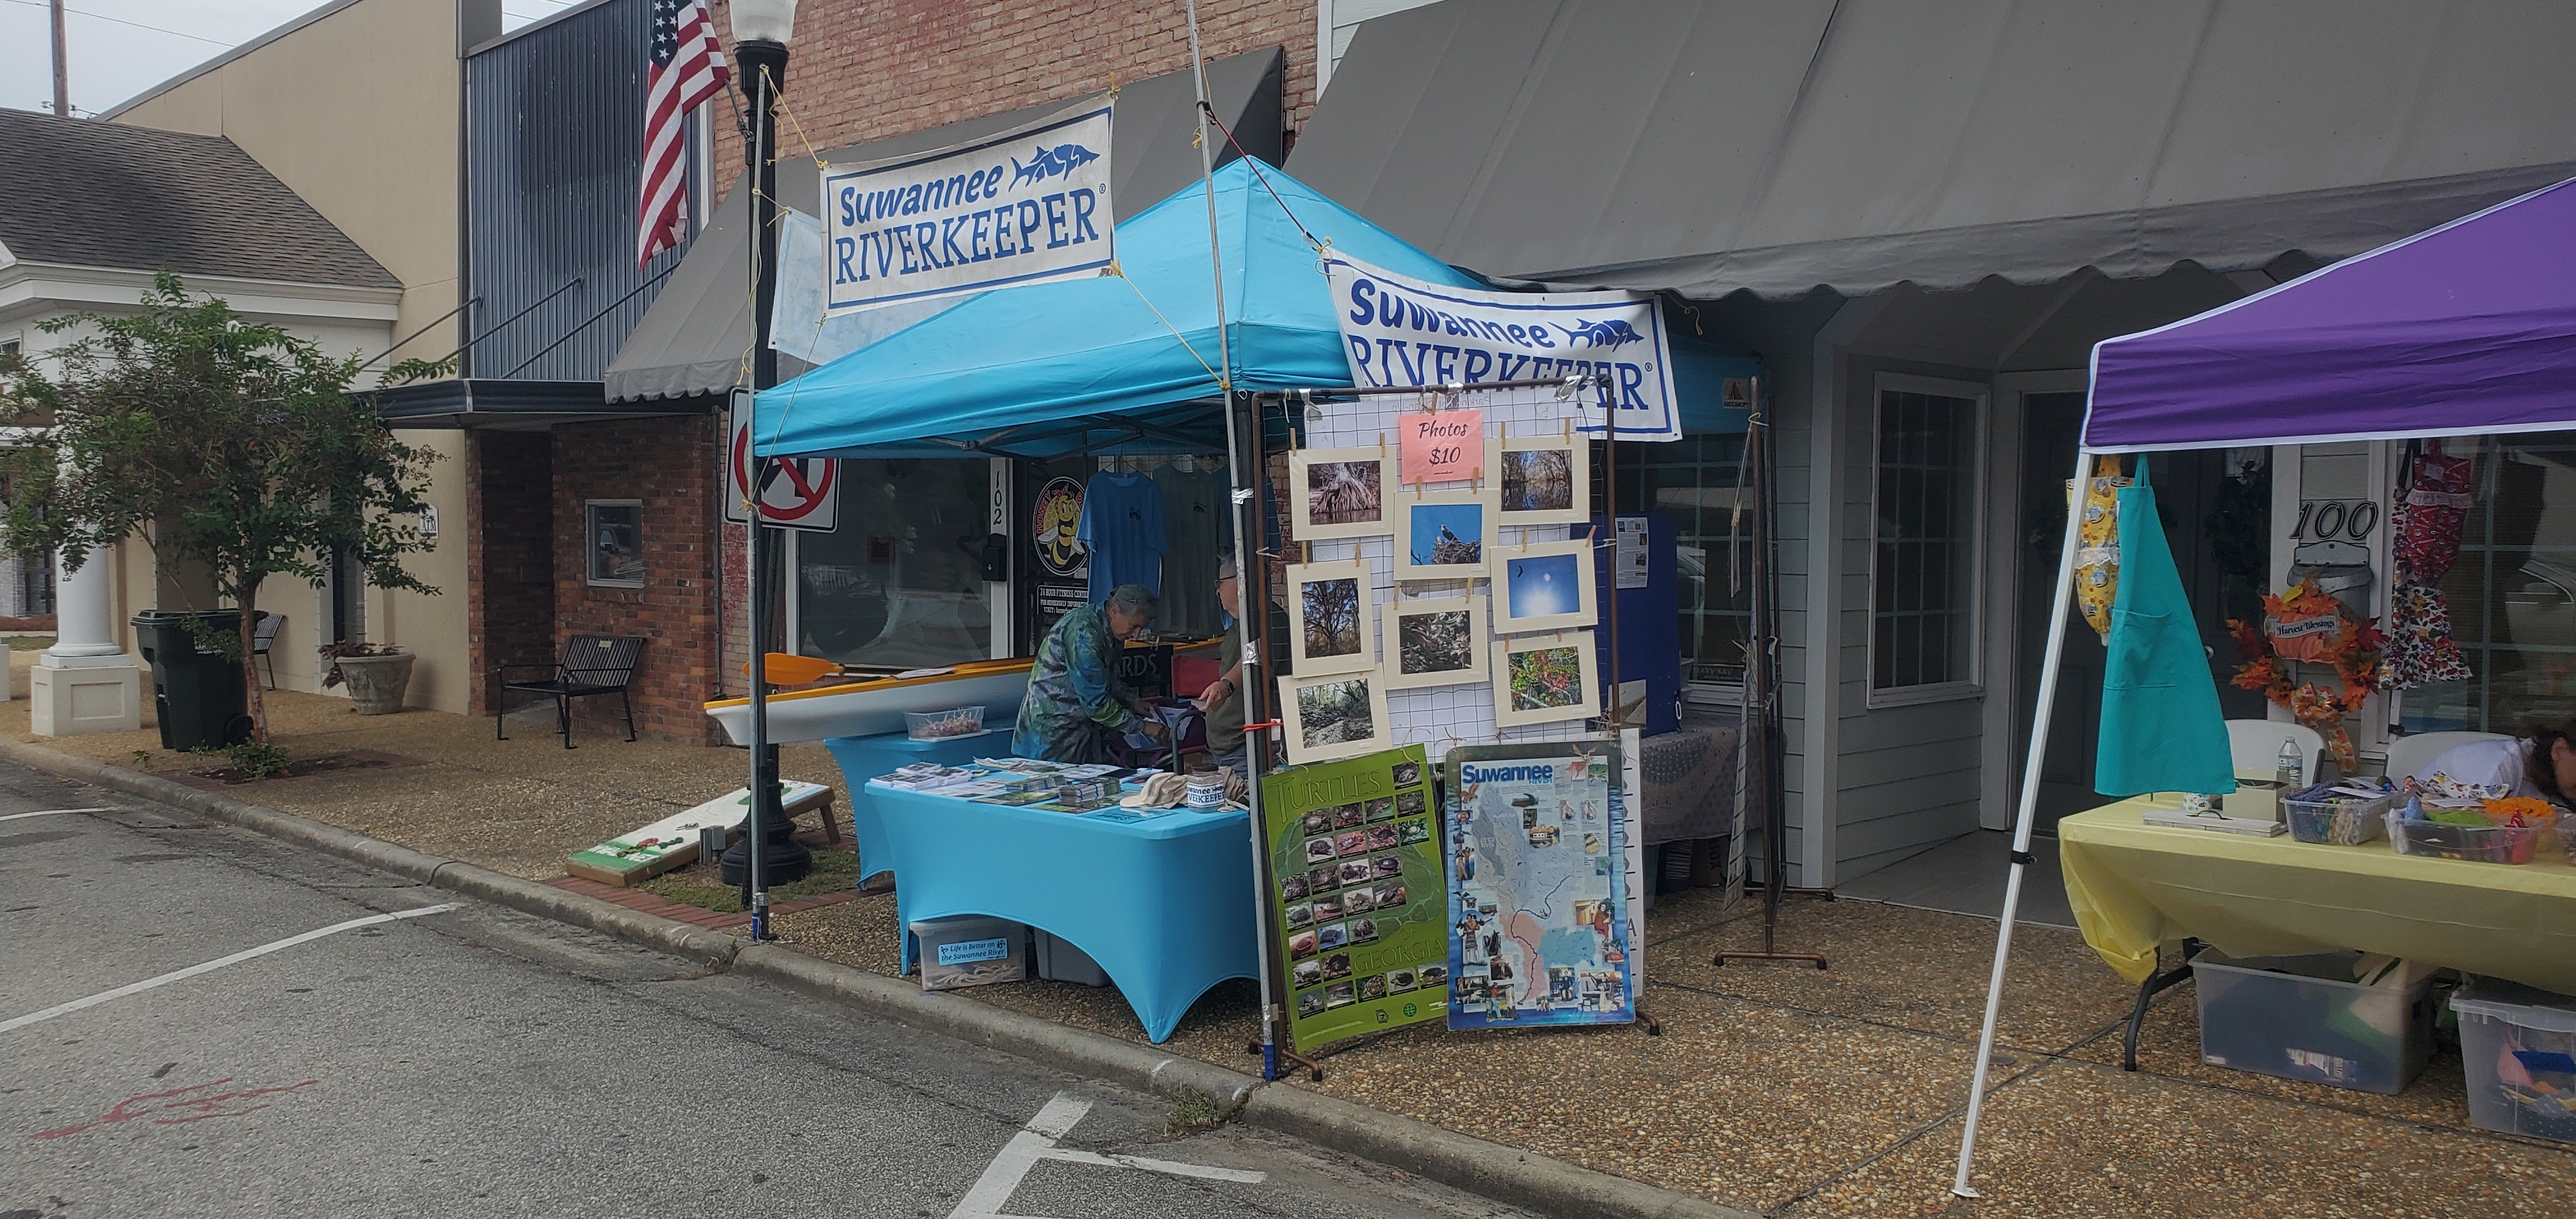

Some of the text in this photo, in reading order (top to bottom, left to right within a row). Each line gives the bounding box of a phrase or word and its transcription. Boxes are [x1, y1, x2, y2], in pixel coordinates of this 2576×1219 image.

[840, 165, 1004, 227] Suwannee
[1350, 279, 1556, 348] Suwannee
[1418, 420, 1469, 440] Photos
[1429, 447, 1461, 467] $10
[993, 470, 1002, 526] 102
[1036, 489, 1052, 534] HONEY
[2288, 500, 2379, 540] 100
[422, 519, 436, 532] ATM
[1039, 588, 1046, 596] 24
[1074, 590, 1088, 599] CENTE
[2276, 620, 2335, 636] Harvest Blessings
[1717, 668, 1733, 677] KAY
[1462, 764, 1553, 784] Suwannee
[1268, 769, 1382, 824] TURTLES
[1399, 927, 1418, 940] OF
[950, 944, 962, 953] Life
[953, 952, 987, 960] Suwannee
[988, 948, 1005, 956] River
[1353, 937, 1448, 973] GEORGIA
